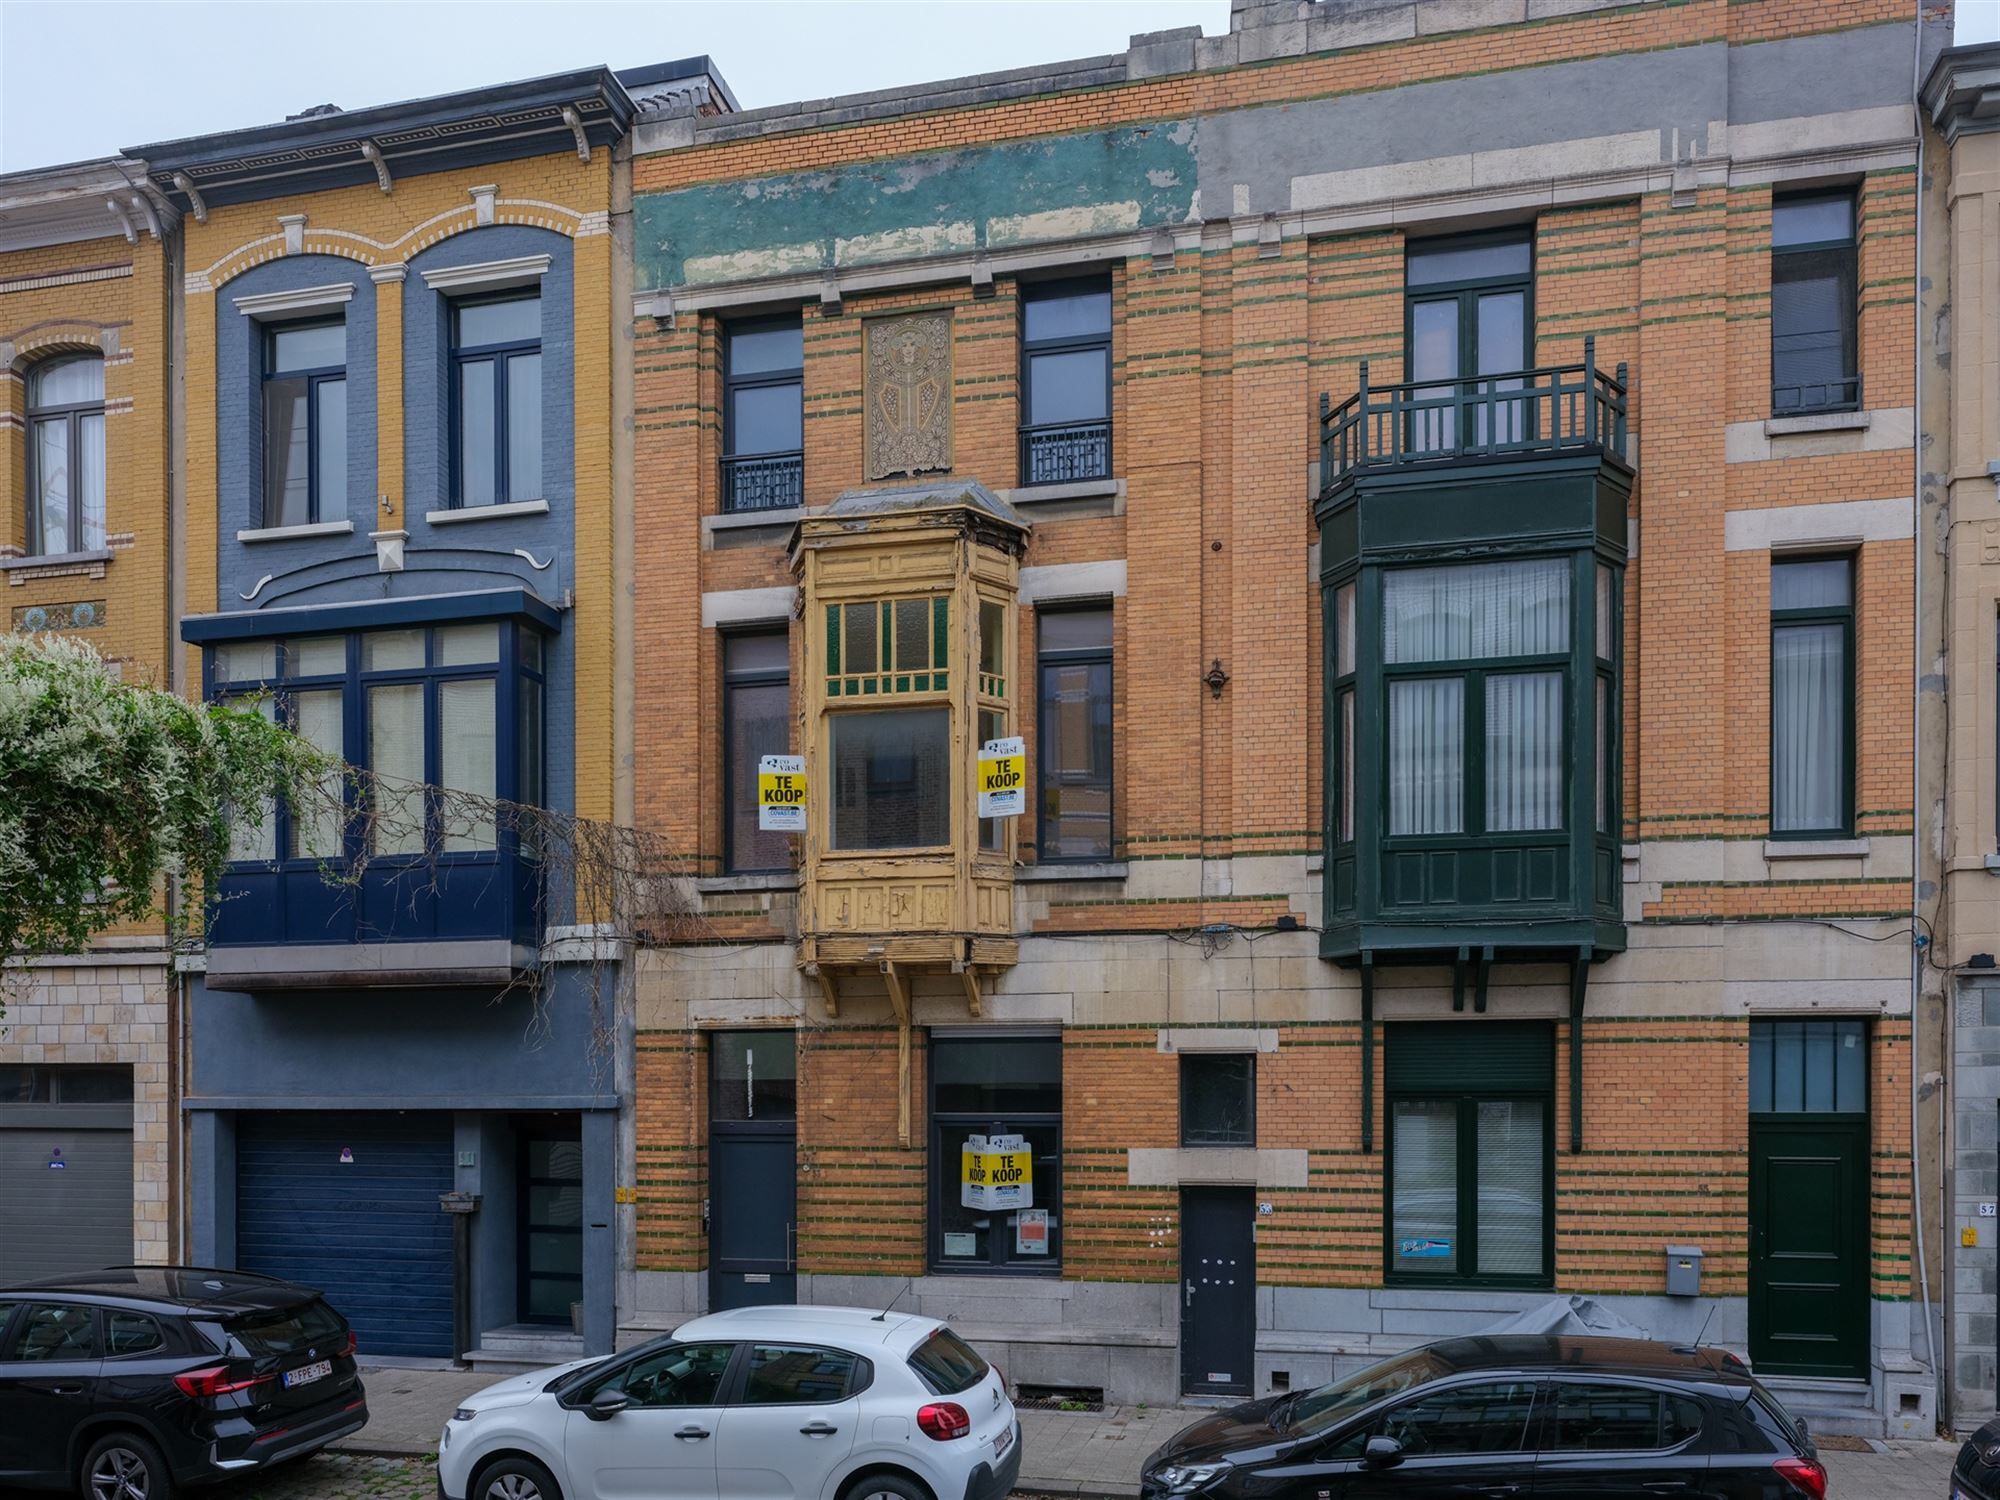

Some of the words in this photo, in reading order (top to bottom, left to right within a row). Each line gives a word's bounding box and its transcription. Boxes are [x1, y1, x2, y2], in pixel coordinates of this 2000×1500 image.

[780, 764, 800, 772] vast
[996, 760, 1011, 774] TE
[775, 776, 792, 789] TE
[987, 772, 1020, 789] KOOP
[764, 789, 803, 802] KOOP
[973, 1155, 981, 1169] TE
[1000, 1156, 1014, 1169] TE
[969, 1168, 986, 1182] KOOP
[992, 1168, 1023, 1183] KOOP
[1981, 1205, 1995, 1214] 57
